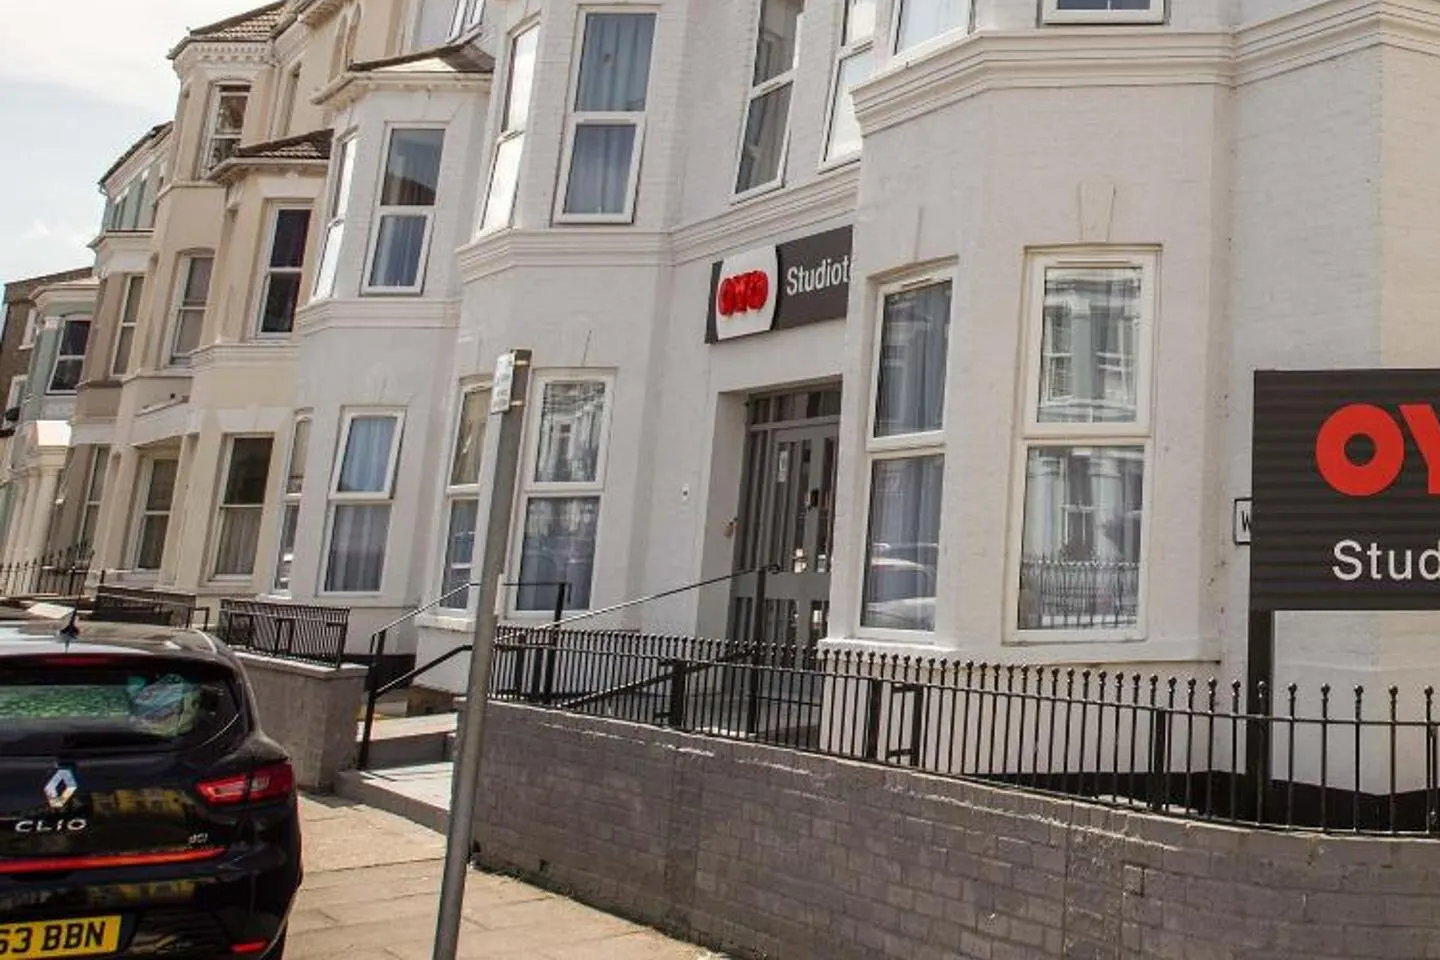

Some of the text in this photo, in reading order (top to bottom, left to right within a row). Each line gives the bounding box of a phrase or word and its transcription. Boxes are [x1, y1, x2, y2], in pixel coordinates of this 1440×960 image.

[786, 255, 853, 296] Studiot
[15, 818, 87, 833] CLIO
[41, 921, 106, 951] BBN
